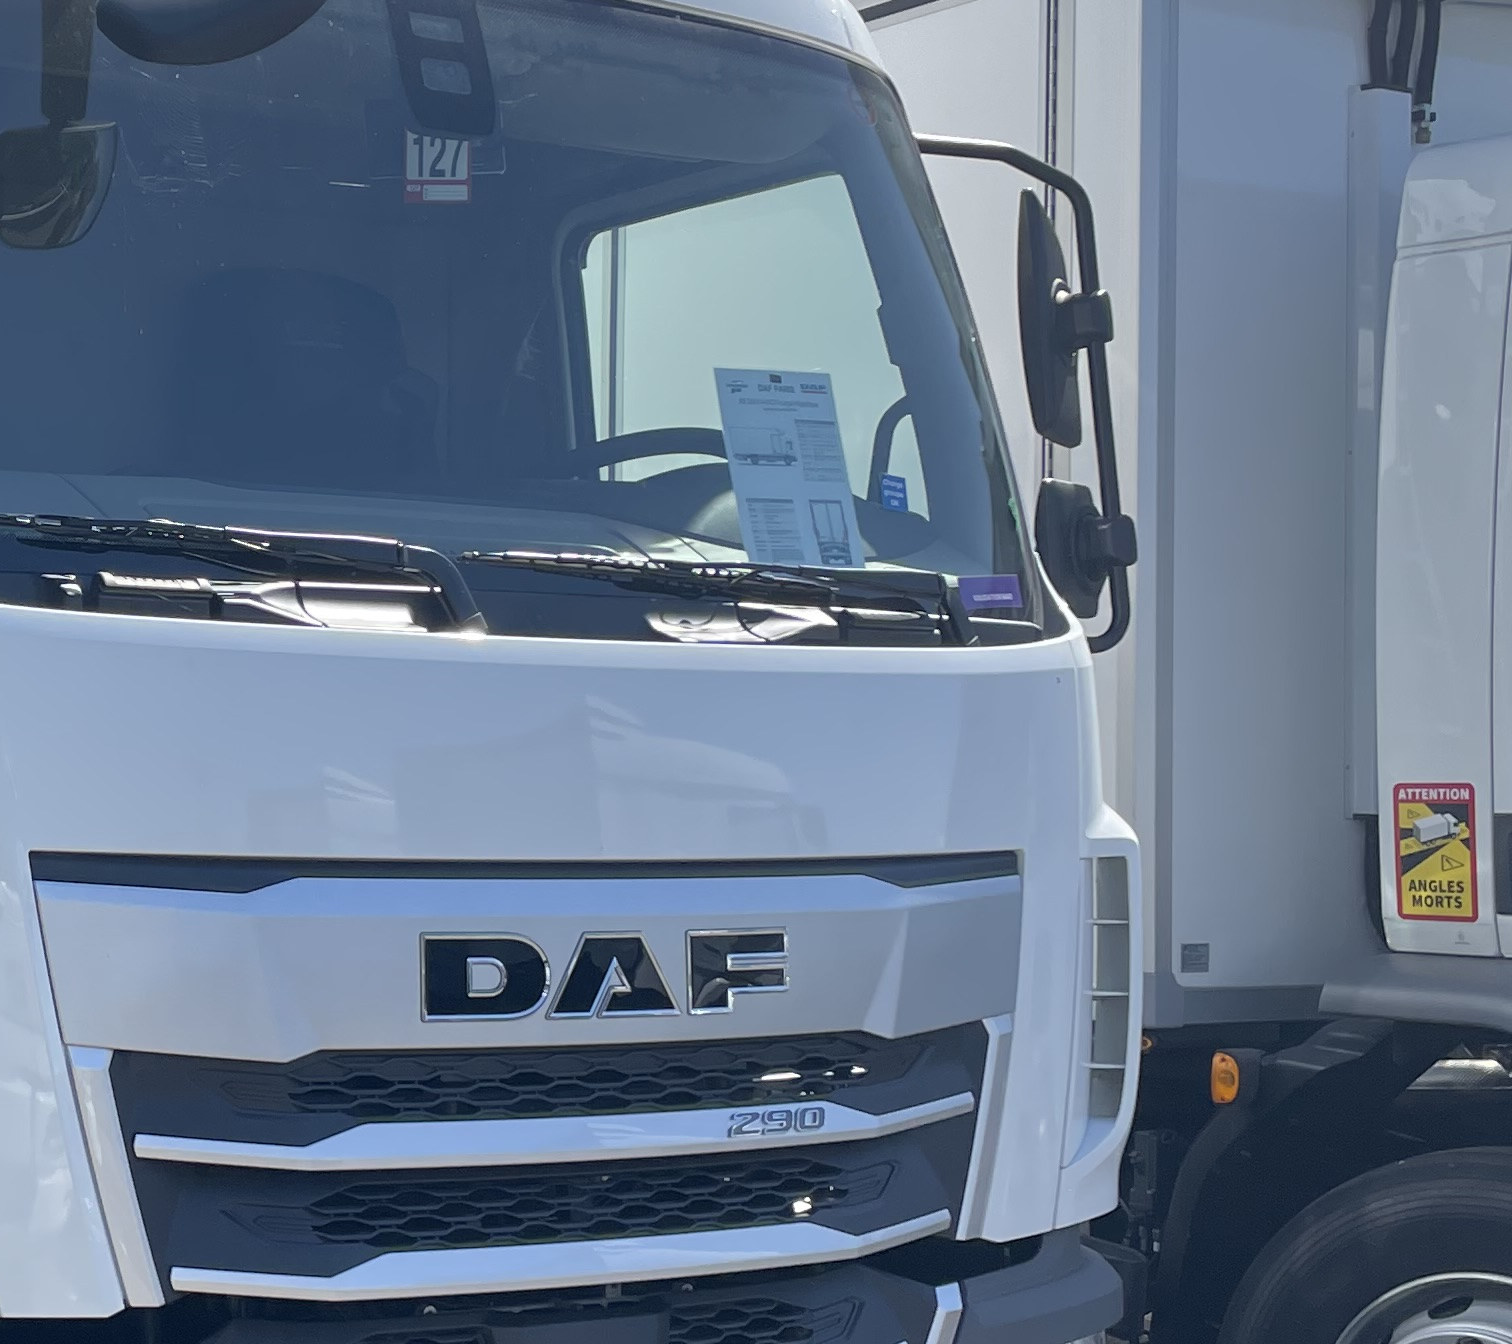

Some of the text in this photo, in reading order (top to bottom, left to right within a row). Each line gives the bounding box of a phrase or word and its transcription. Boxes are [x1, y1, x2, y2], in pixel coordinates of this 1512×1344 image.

[413, 135, 466, 178] 127
[1398, 787, 1470, 801] ATTENTION
[1408, 879, 1465, 894] ANGLES
[1412, 894, 1463, 909] MORTS
[419, 926, 789, 1023] DAF
[727, 1106, 826, 1138] 290
